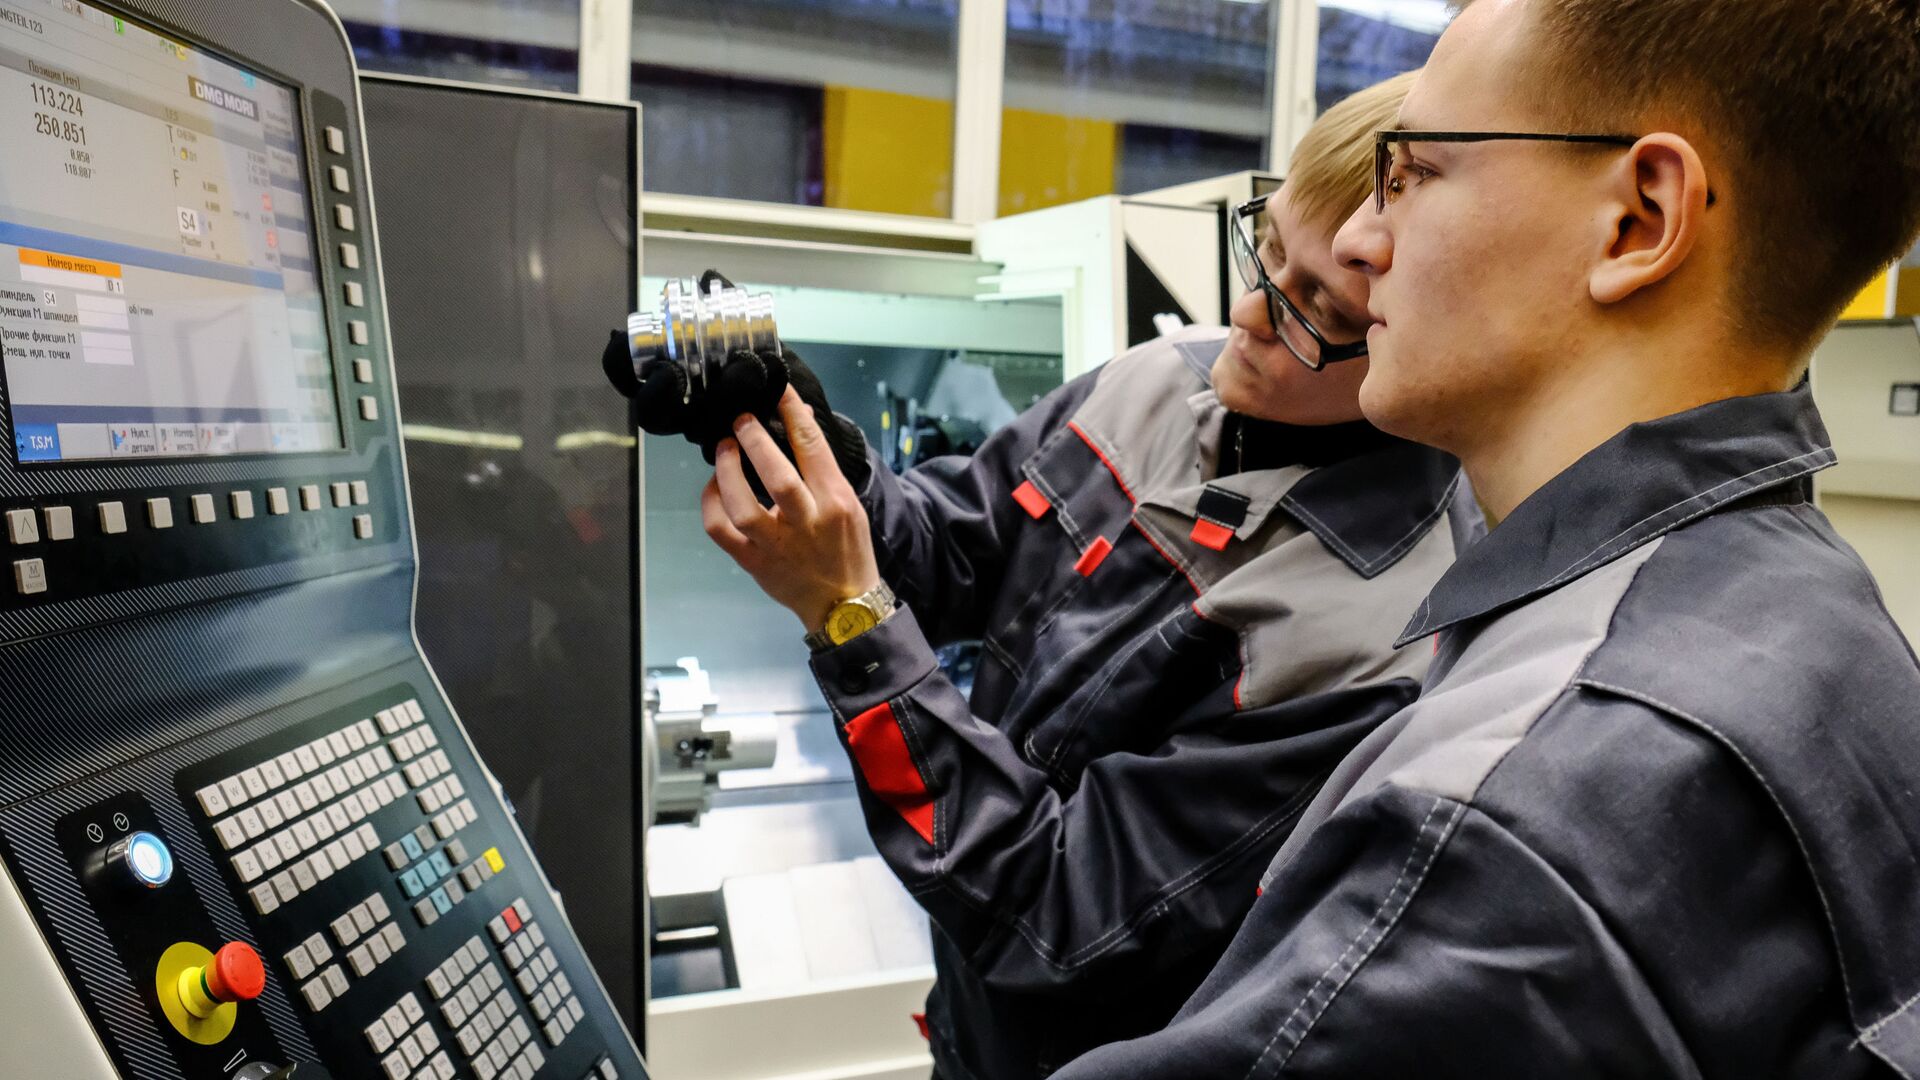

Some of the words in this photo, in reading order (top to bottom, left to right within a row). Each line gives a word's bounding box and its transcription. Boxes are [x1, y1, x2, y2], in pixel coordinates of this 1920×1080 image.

[0, 8, 43, 34] NGTEIL123
[31, 82, 83, 117] 113.224
[195, 81, 223, 106] DMG
[224, 91, 255, 117] MORI
[35, 112, 86, 146] 250.851
[181, 211, 196, 231] S4
[46, 255, 73, 271] Номер
[74, 263, 97, 274] места
[44, 292, 56, 304] S4
[48, 350, 71, 359] точки
[30, 436, 54, 450] T,S,M
